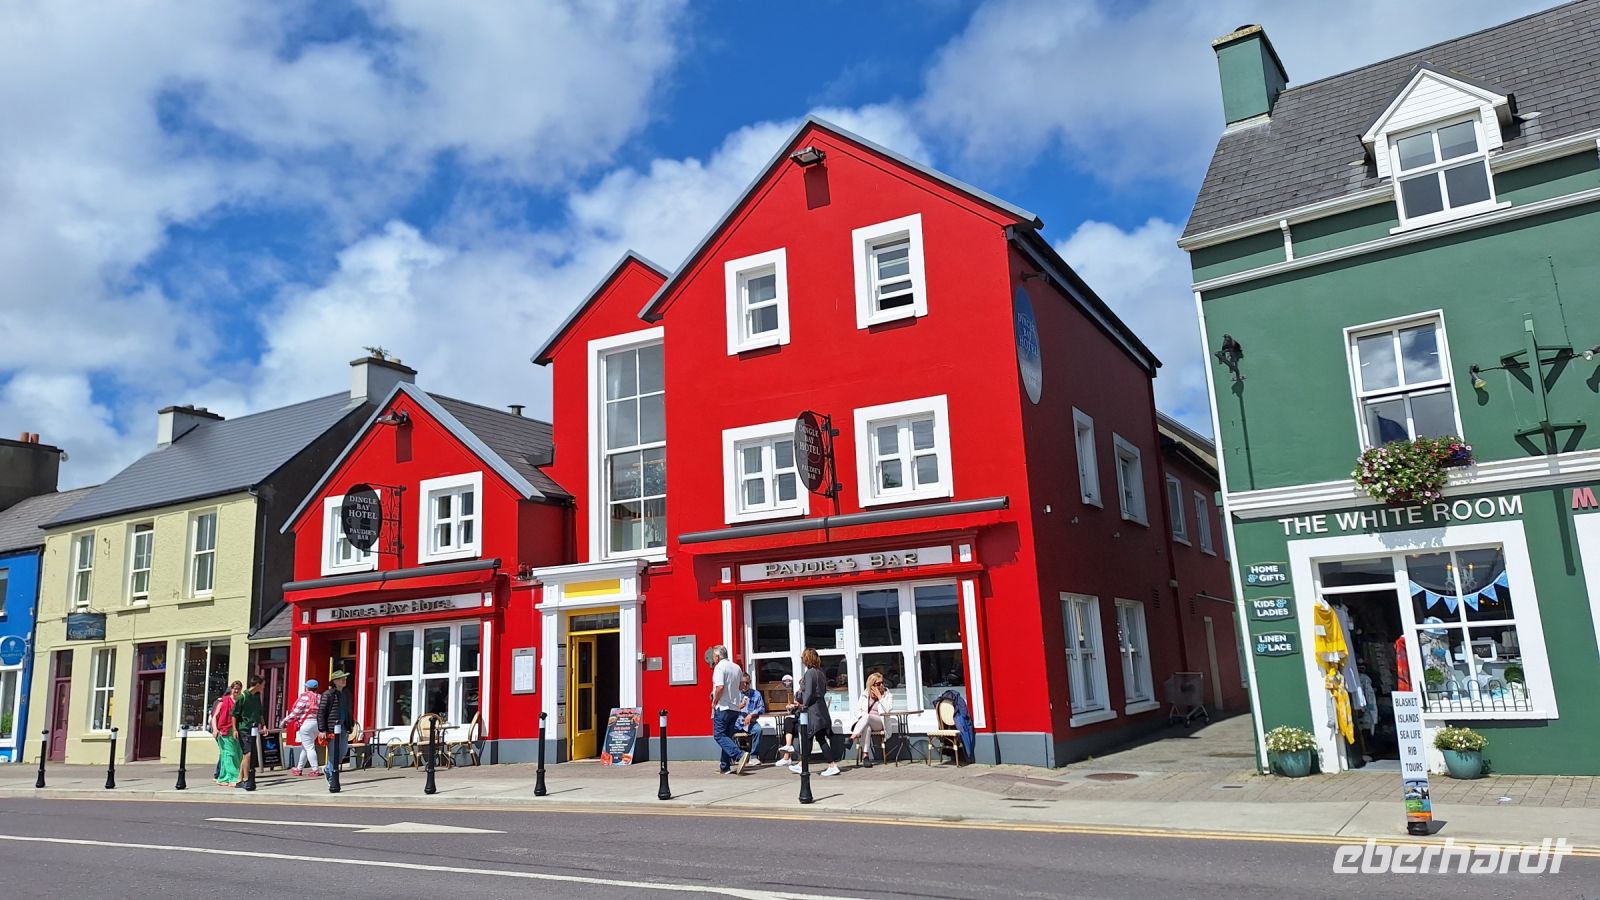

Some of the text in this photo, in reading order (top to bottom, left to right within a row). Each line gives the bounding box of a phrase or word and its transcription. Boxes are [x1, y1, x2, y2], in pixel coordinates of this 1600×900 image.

[798, 424, 819, 437] DINGLE
[804, 435, 814, 444] BAY
[799, 442, 820, 455] HOTEL
[807, 472, 816, 480] BAR
[349, 495, 377, 505] DINGLE
[356, 503, 370, 511] BAY
[348, 509, 378, 520] HOTEL
[1278, 494, 1524, 536] THE WHITE ROOM
[349, 527, 377, 536] PAUDIE'S
[765, 552, 918, 577] PAUDIE'S BAR
[1250, 565, 1278, 573] HOME
[1247, 573, 1286, 583] & GIFTS
[1253, 599, 1287, 608] KIDS &
[330, 599, 456, 619] DINGLE BAY HOTEL
[1256, 607, 1289, 617] LADIES
[1258, 634, 1287, 643] LINEN
[1257, 643, 1292, 652] & LACE
[1395, 697, 1418, 707] BLASKET
[1397, 713, 1419, 723] ISLANDS
[1399, 729, 1421, 740] SEA LIFE
[1407, 746, 1417, 756] RIB
[1405, 762, 1424, 772] TOURS
